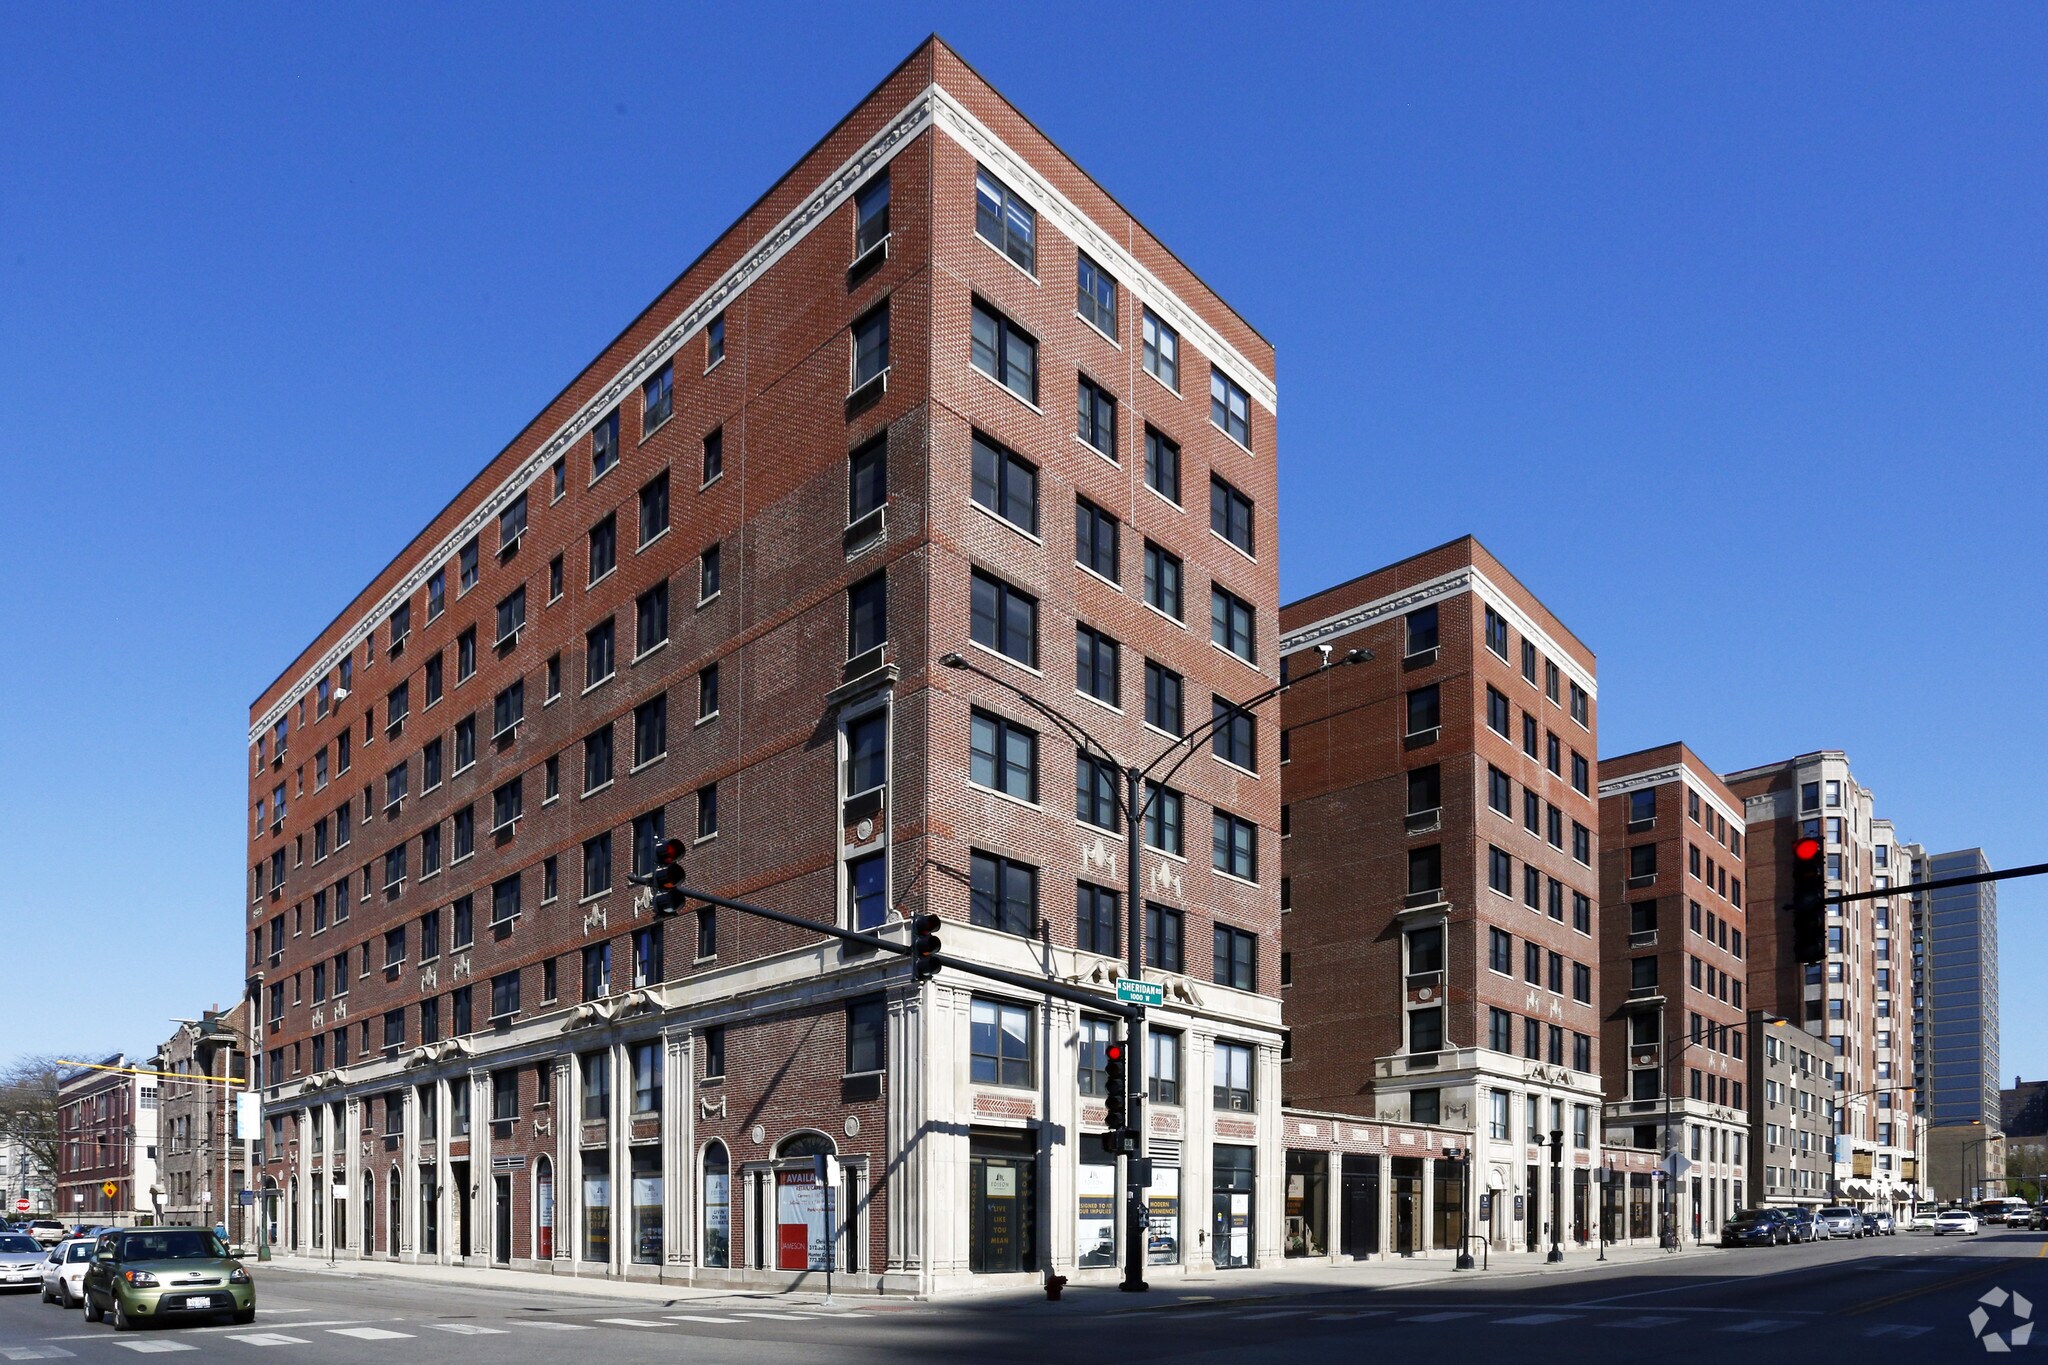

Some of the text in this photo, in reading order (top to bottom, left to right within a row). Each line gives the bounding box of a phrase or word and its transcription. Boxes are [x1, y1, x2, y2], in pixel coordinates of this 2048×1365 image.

[1122, 981, 1156, 995] SHERIDAN
[1155, 987, 1162, 995] RD
[782, 1242, 805, 1250] JAMESON
